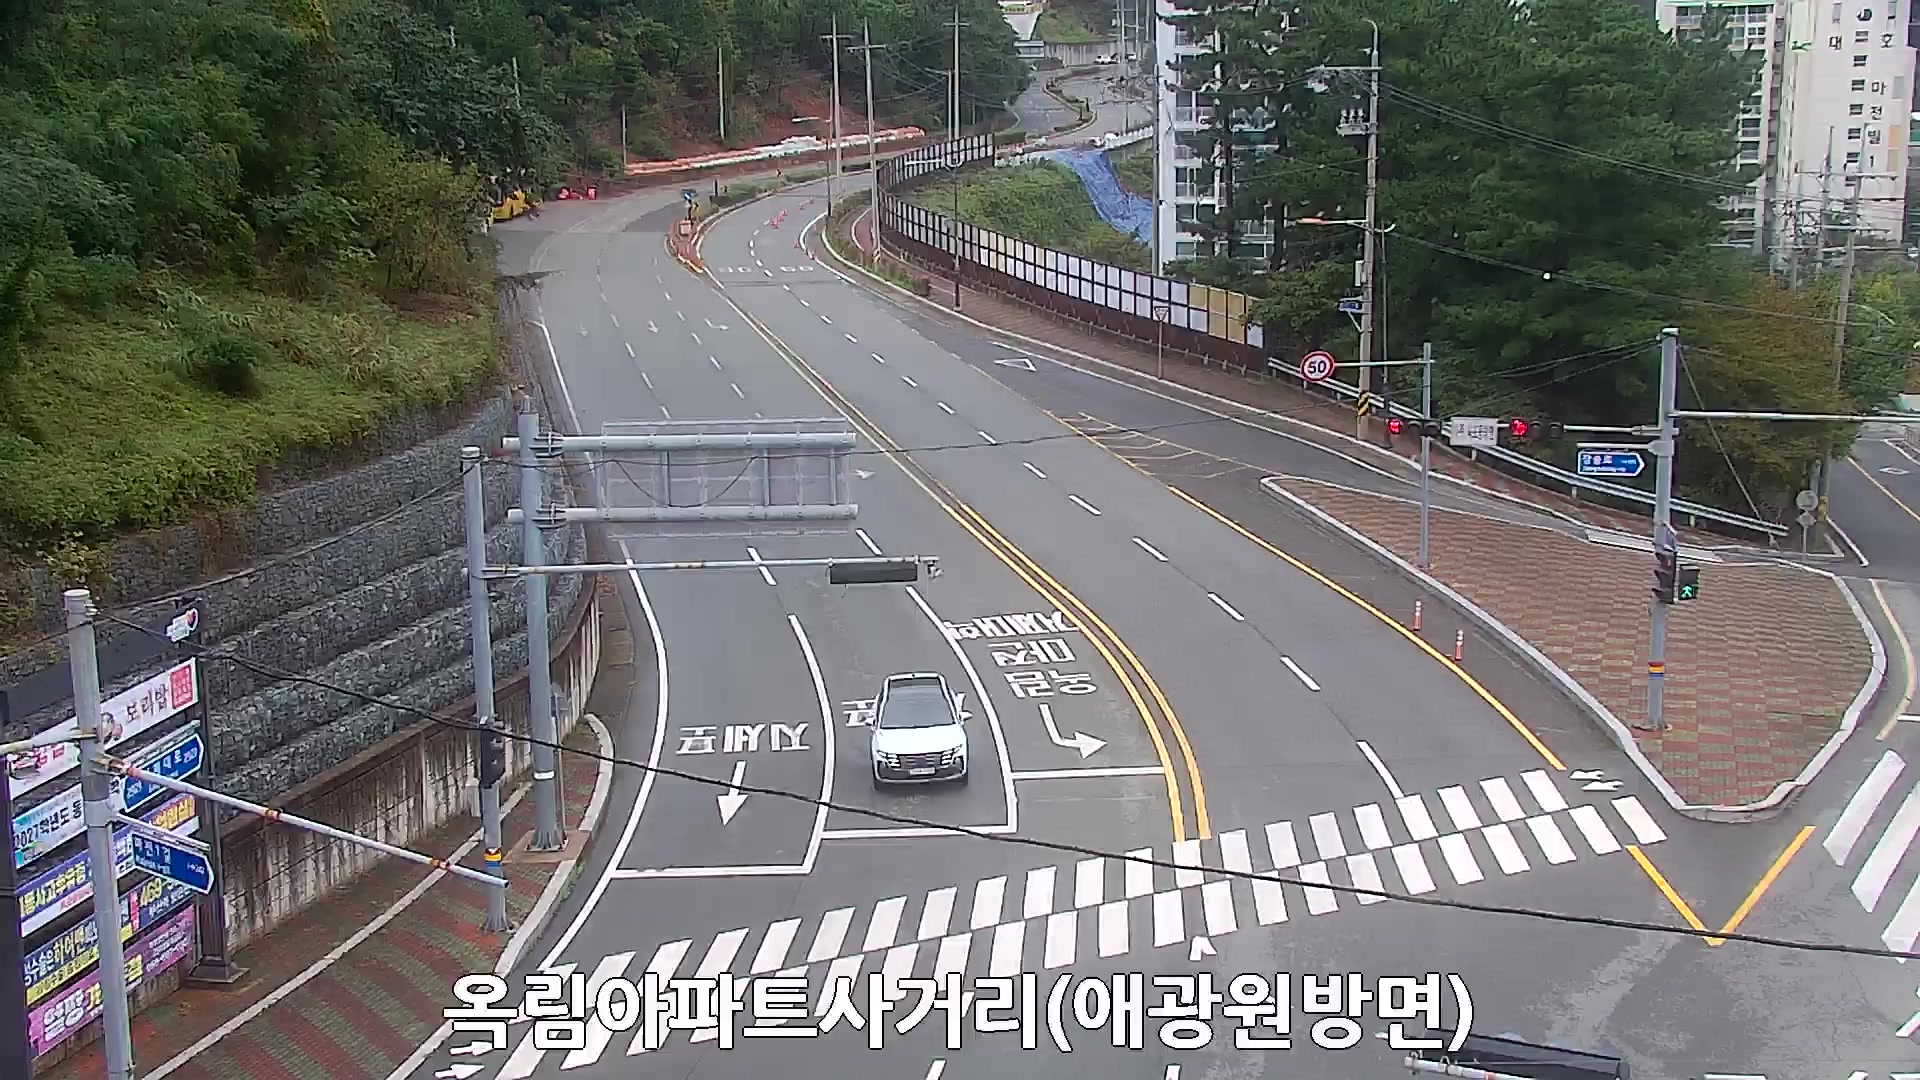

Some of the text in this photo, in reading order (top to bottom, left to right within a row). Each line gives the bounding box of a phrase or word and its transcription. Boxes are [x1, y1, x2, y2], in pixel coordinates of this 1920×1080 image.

[1307, 360, 1327, 374] 50
[943, 611, 1080, 641] 거제대학
[987, 638, 1077, 668] 마전
[1003, 669, 1098, 699] 옥림
[676, 722, 811, 755] 지세포
[19, 861, 86, 917] 통사고후유증
